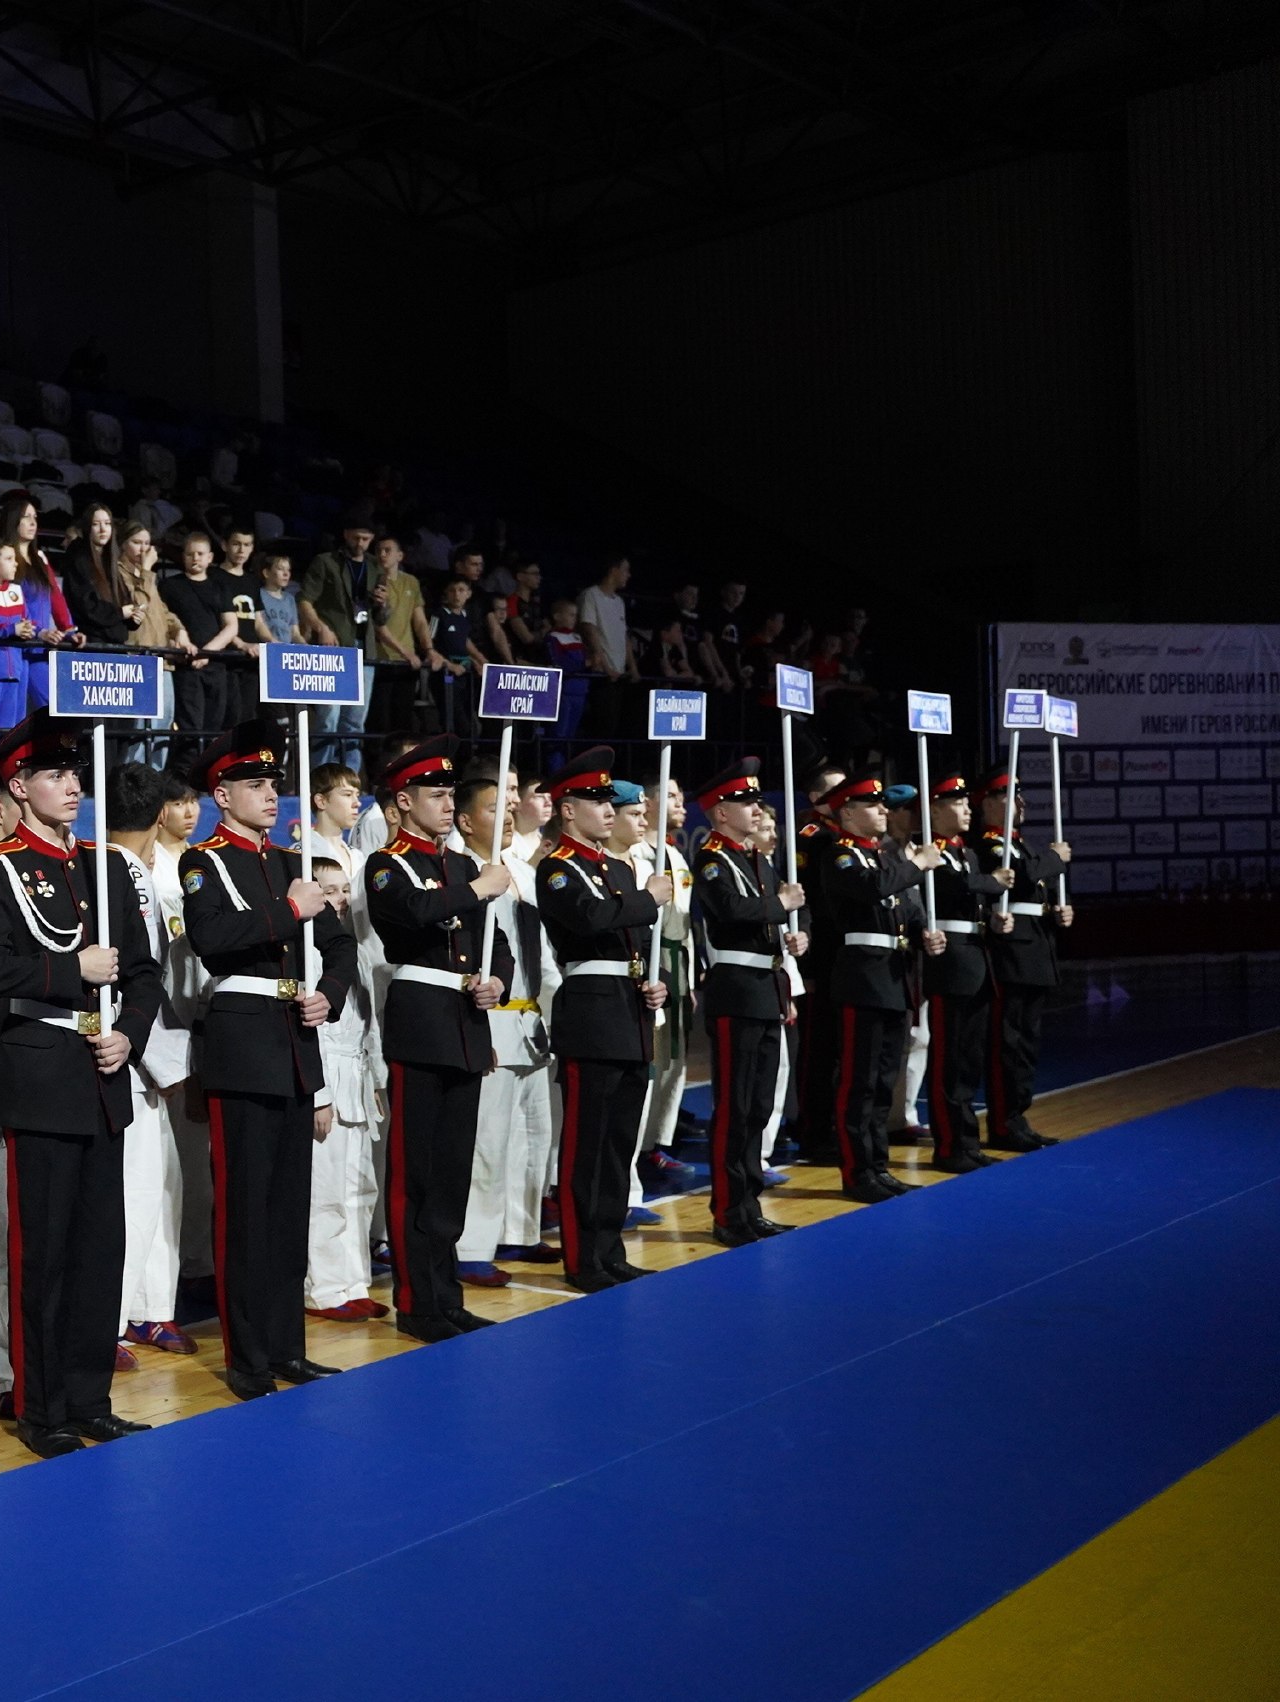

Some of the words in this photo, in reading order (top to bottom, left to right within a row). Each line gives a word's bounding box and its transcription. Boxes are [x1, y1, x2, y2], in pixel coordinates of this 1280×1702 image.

[71, 660, 145, 683] РЕСПУБЛИКА
[282, 652, 346, 673] РЕСПУБЛИКА
[292, 673, 336, 693] БУРЯТИЯ
[497, 670, 550, 692] АЛТАЙСКИЙ
[1017, 668, 1146, 695] ВСЕРОССИЙСКИЕ
[1149, 671, 1266, 695] СОРЕВНОВАНИЯ
[82, 685, 134, 707] ХАКАСИЯ
[510, 693, 534, 714] КРАЙ
[671, 714, 687, 731] КРАЙ
[1141, 715, 1188, 735] ИМЕНИ
[1191, 715, 1232, 734] ГЕРОЯ
